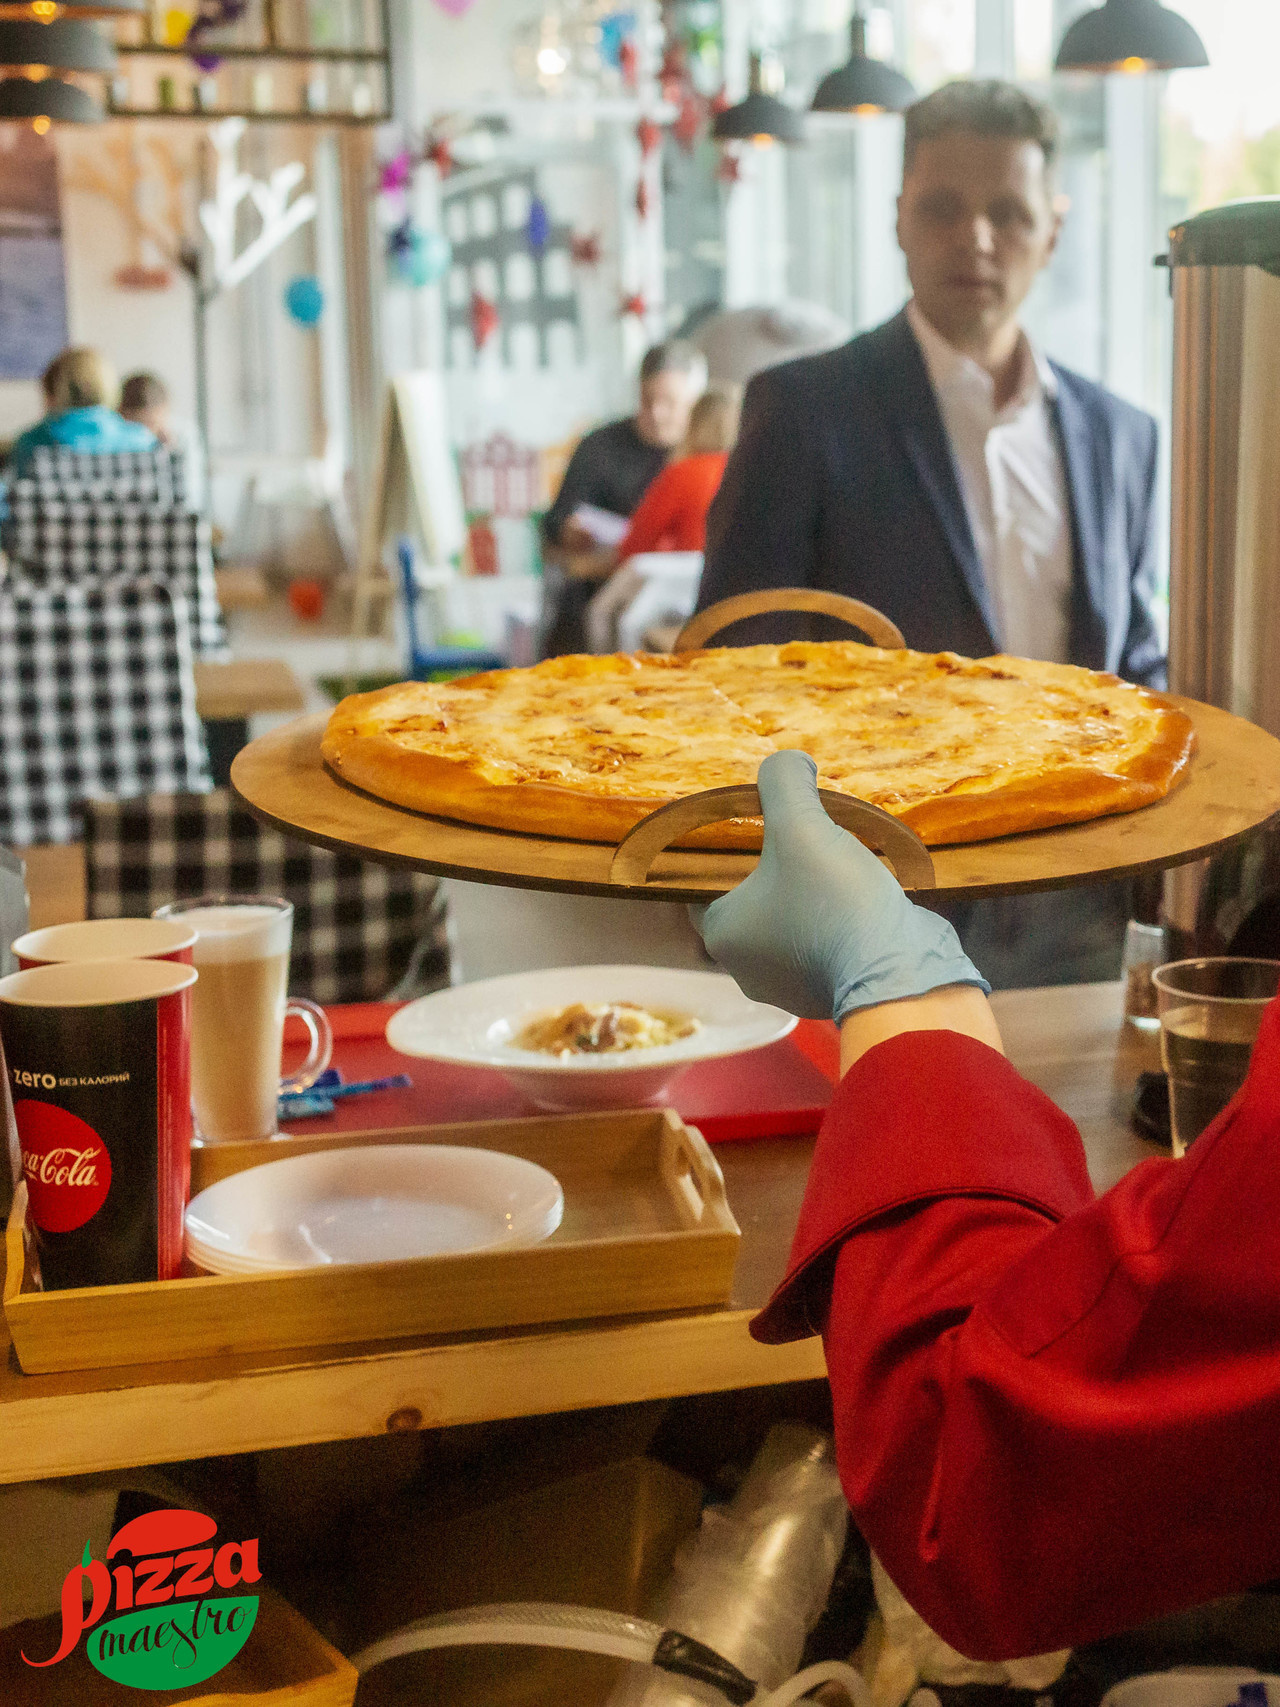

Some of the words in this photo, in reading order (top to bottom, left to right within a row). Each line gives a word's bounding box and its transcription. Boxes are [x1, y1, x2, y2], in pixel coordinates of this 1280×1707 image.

[13, 1068, 57, 1089] zero
[59, 1076, 79, 1087] БЕЗ
[79, 1071, 131, 1086] КАЛОРИЙ
